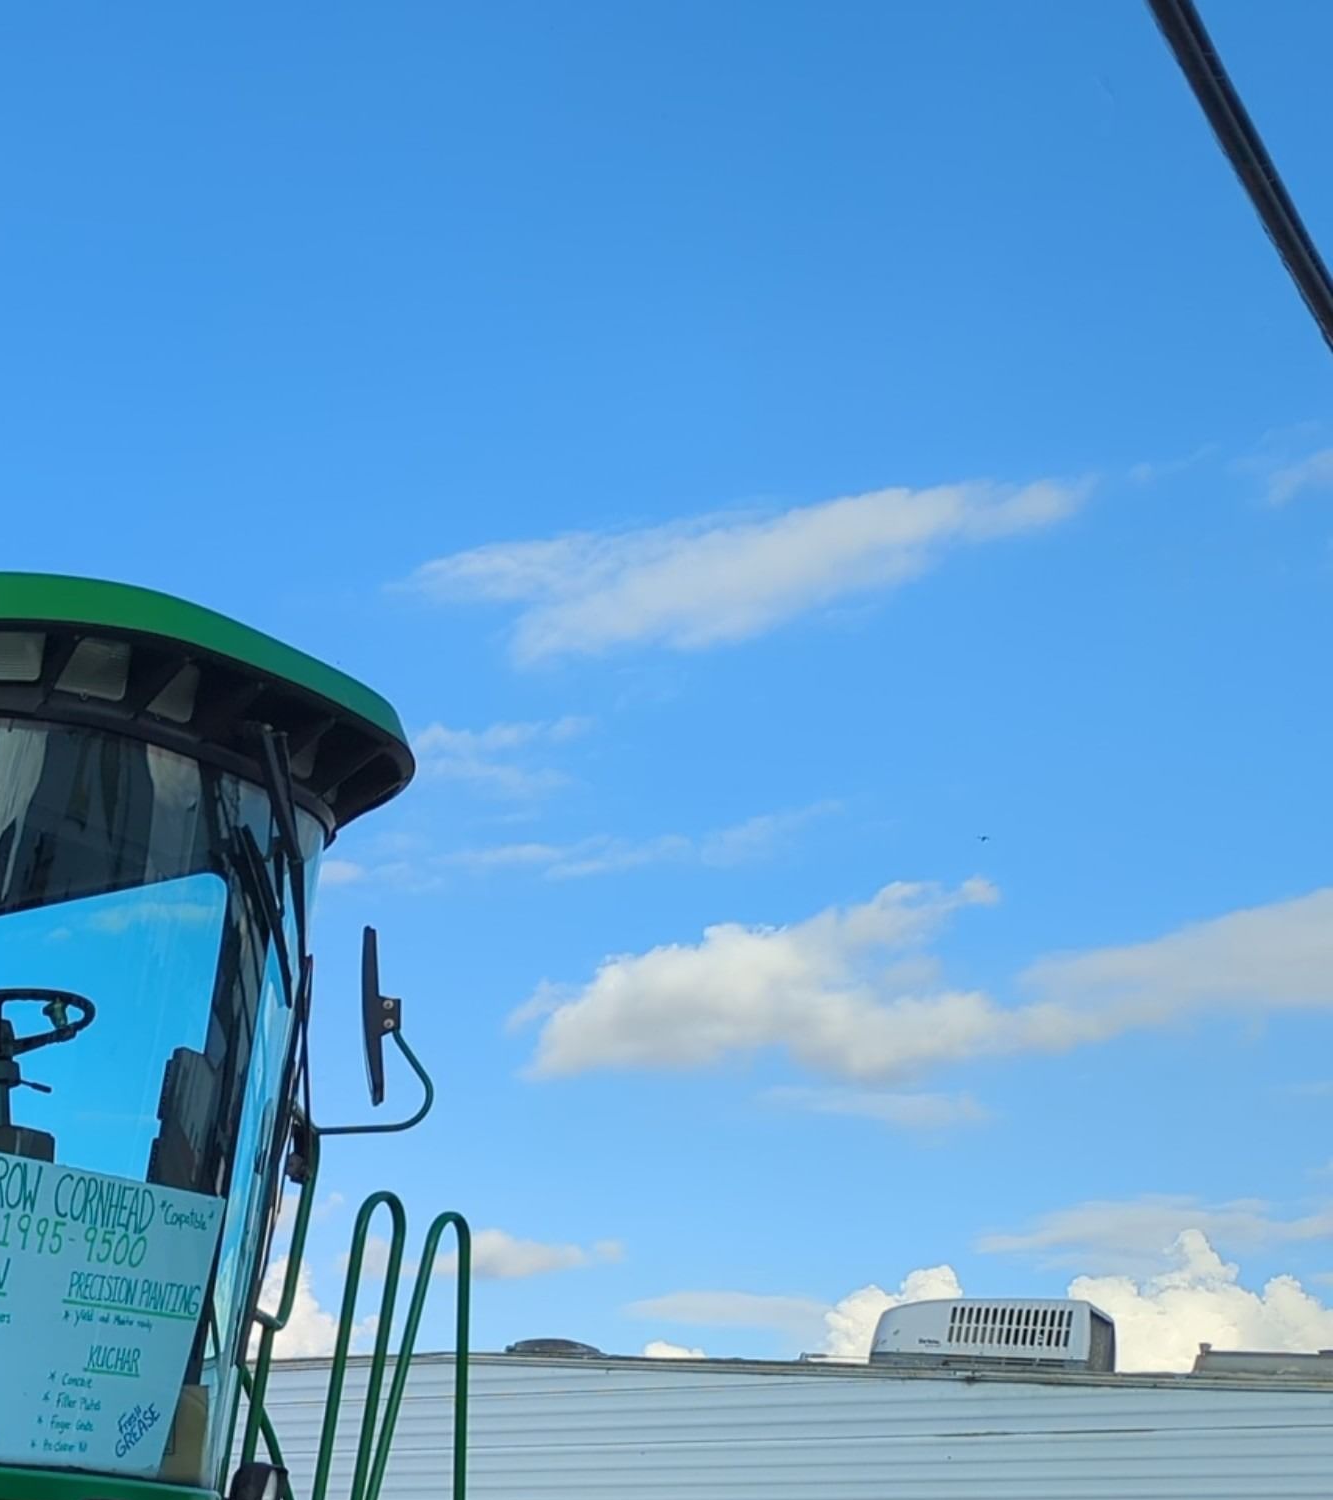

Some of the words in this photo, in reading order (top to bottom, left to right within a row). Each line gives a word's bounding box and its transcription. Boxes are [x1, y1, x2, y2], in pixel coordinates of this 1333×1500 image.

[54, 1173, 155, 1234] CORNHEAD
[68, 1271, 138, 1305] PRECISION
[87, 1344, 141, 1374] KUCHAR
[115, 1403, 160, 1458] GREASE
